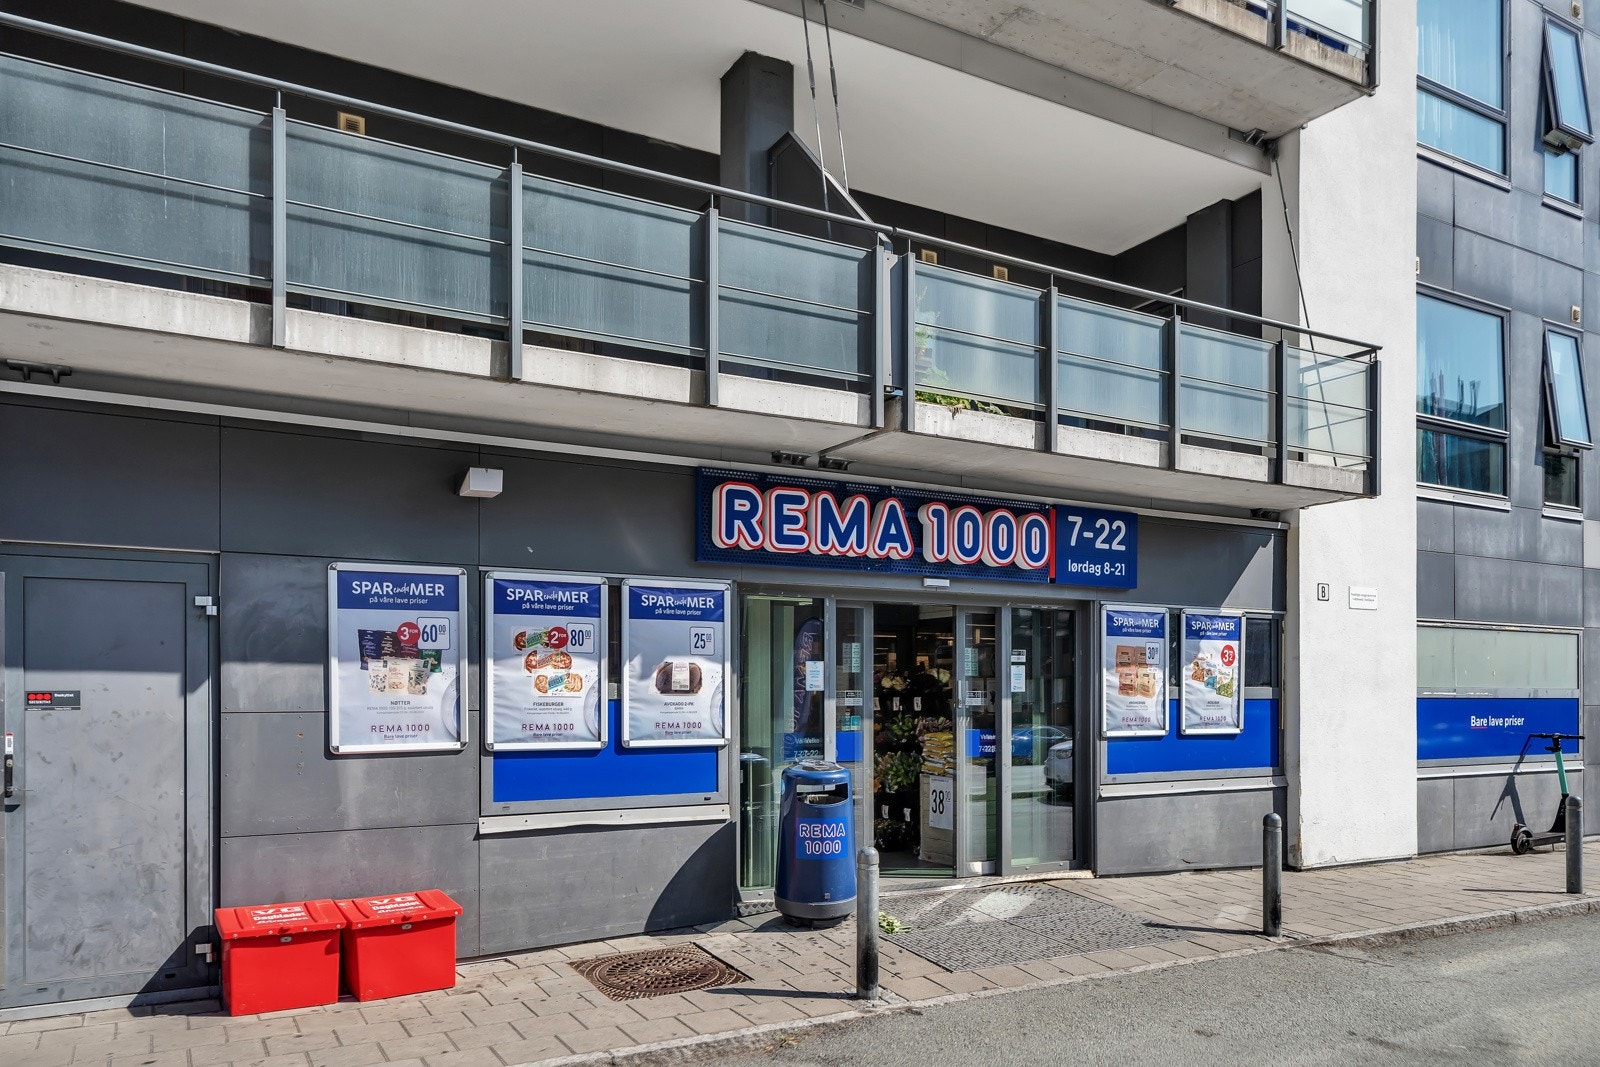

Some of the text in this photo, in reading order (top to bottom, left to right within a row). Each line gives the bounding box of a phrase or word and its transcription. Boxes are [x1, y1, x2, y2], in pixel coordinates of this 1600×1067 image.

[712, 481, 1050, 569] REMA 1000
[1067, 515, 1126, 551] 7-22
[1067, 560, 1126, 578] lørdag 8-21
[352, 581, 393, 595] SPAR
[410, 583, 444, 597] MER
[506, 588, 544, 601] SPAR
[558, 590, 588, 604] MER
[641, 594, 674, 606] SPAR
[686, 596, 714, 608] MER
[1113, 616, 1134, 626] SPAR
[1142, 618, 1160, 628] MER
[1192, 621, 1212, 630] SPAR
[1218, 622, 1234, 630] MER
[400, 626, 410, 640] 3
[422, 624, 438, 642] 60
[550, 631, 558, 644] 2
[570, 630, 584, 646] 80
[694, 632, 706, 650] 25
[1470, 716, 1524, 728] Bare lave priser
[932, 789, 944, 814] 38
[800, 822, 846, 838] REMA
[805, 840, 842, 854] 1000
[253, 912, 306, 920] Dagbladet
